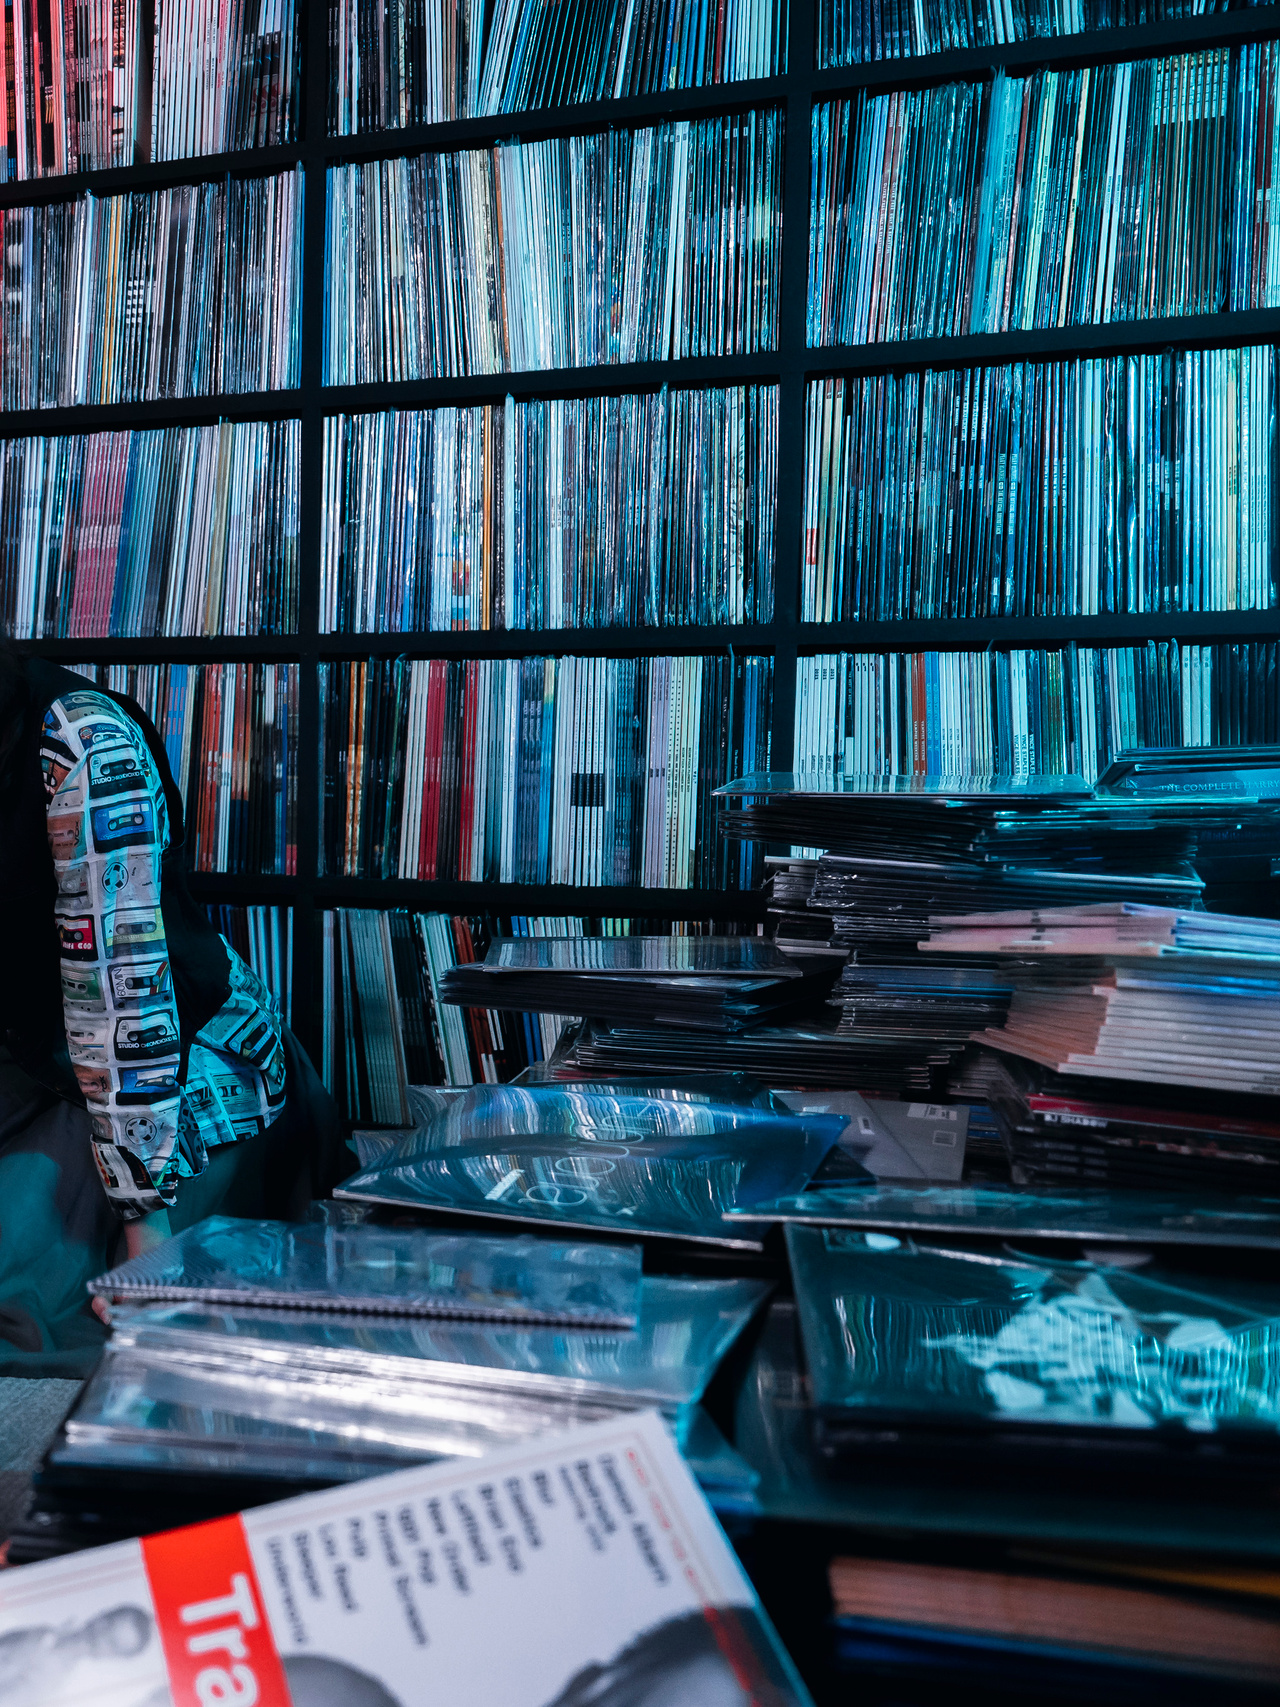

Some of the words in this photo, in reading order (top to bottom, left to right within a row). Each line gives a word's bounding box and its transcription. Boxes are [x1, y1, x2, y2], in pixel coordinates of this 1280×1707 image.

[91, 776, 112, 786] STUDIO
[1182, 781, 1240, 792] COMPLETE
[180, 1573, 259, 1707] Tra
